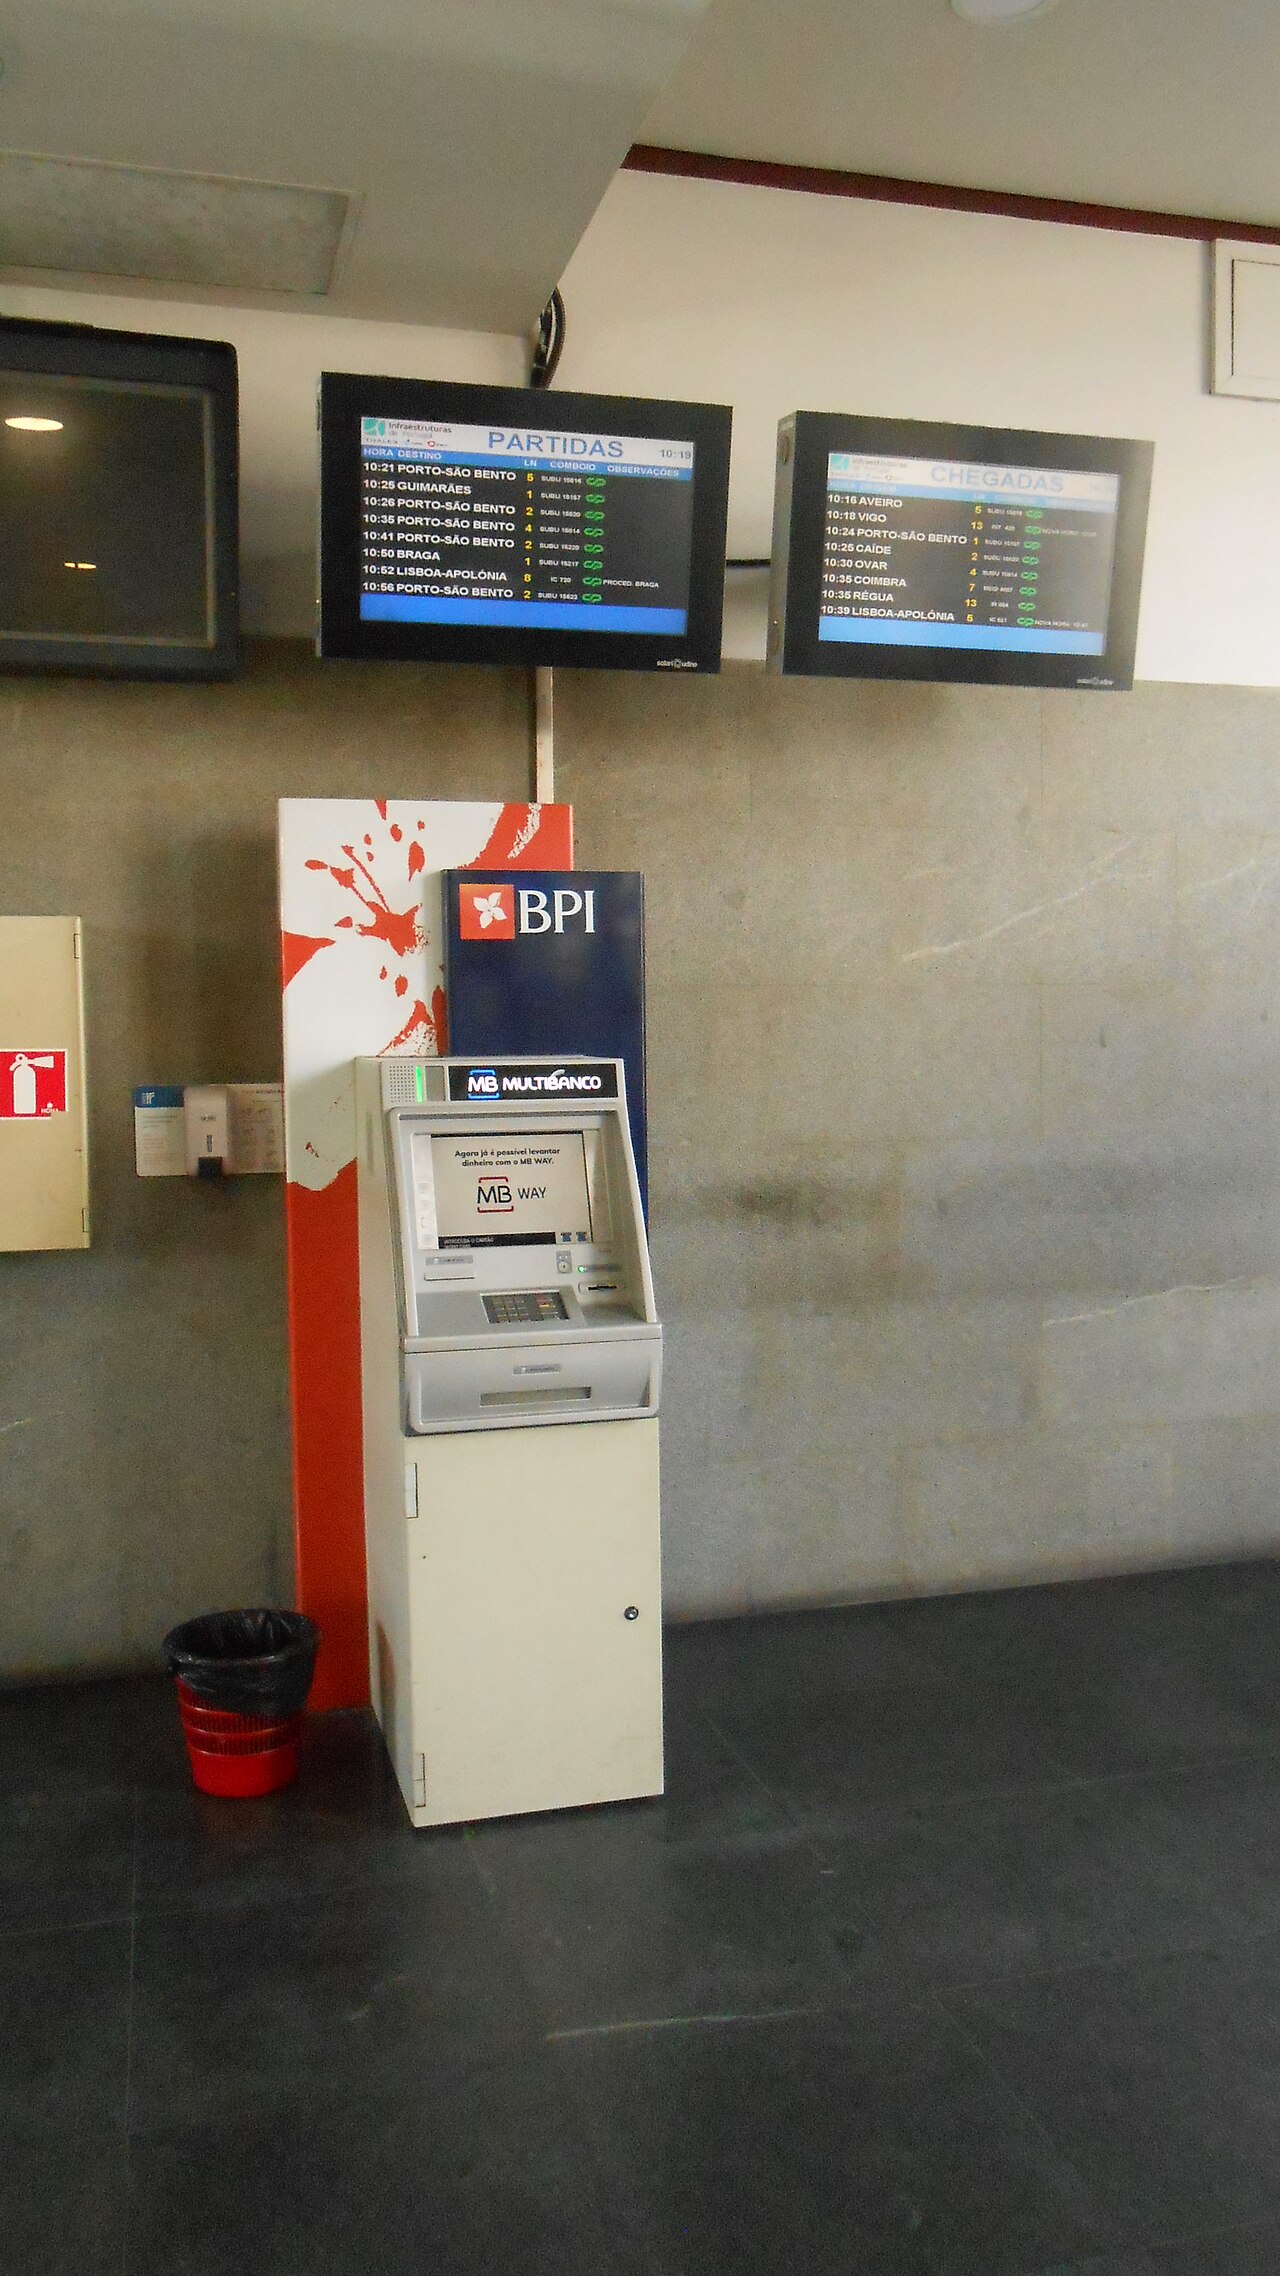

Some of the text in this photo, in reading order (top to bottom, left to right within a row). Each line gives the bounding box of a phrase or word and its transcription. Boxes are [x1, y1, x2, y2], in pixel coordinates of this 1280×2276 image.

[389, 422, 451, 433] Infraestruturas
[488, 431, 692, 460] PARTIDAS 10:19
[364, 447, 393, 458] HORA
[397, 449, 442, 460] DESTINO
[550, 462, 596, 471] COMBOIO
[363, 462, 394, 474] 10:21
[397, 464, 470, 479] PORTO-SÃO
[473, 469, 516, 482] BENTO
[527, 474, 534, 482] 5
[930, 465, 1064, 493] CHEGADAS
[363, 480, 395, 491] 10:25
[397, 480, 471, 495] GUIMARÃES
[527, 491, 533, 499] 1
[363, 497, 395, 508] 10:26
[397, 498, 470, 512] PORTO-SÃO
[473, 503, 515, 515] BENTO
[526, 507, 534, 516] 2
[828, 494, 857, 505] 10:16
[859, 496, 902, 508] AVEIRO
[363, 514, 395, 525] 10:35
[397, 515, 470, 529] PORTO-SÃO
[473, 520, 515, 532] BENTO
[525, 524, 532, 532] 4
[858, 512, 887, 523] VIGO
[971, 522, 983, 530] 13
[363, 531, 393, 542] 10:41
[397, 532, 469, 546] PORTO-SÃO
[472, 537, 514, 548] BENTO
[525, 541, 532, 549] 2
[826, 526, 855, 537] 10:24
[857, 527, 926, 542] PORTO-SÃO
[928, 533, 967, 544] BENTO
[973, 537, 978, 545] 1
[362, 548, 395, 559] 10:50
[397, 550, 440, 561] BRAGA
[525, 558, 531, 566] 1
[824, 542, 854, 552] 10:25
[856, 542, 891, 555] CAÍDE
[362, 565, 395, 576] 10:52
[397, 567, 507, 581] LISBOA-APOLÓNIA
[524, 574, 531, 582] 8
[824, 557, 853, 568] 10:30
[855, 559, 887, 570] OVAR
[970, 568, 976, 576] 4
[362, 582, 394, 593] 10:56
[397, 584, 469, 597] PORTO-SÃO
[472, 588, 513, 599] BENTO
[523, 590, 531, 599] 2
[823, 573, 852, 584] 10:35
[854, 575, 906, 586] COIMBRA
[969, 584, 975, 592] 7
[822, 589, 851, 599] 10:35
[853, 590, 894, 602] RÉGUA
[966, 599, 977, 607] 13
[821, 605, 850, 615] 10:39
[852, 606, 954, 621] LISBOA-APOLÓNIA
[966, 614, 974, 622] 5
[518, 890, 595, 934] BPI
[468, 1075, 601, 1092] MB MULTIBANCO
[455, 1150, 479, 1158] Agora
[481, 1149, 488, 1157] já
[496, 1148, 527, 1157] possível
[462, 1159, 493, 1167] dinheiro
[477, 1186, 546, 1204] MB WAY
